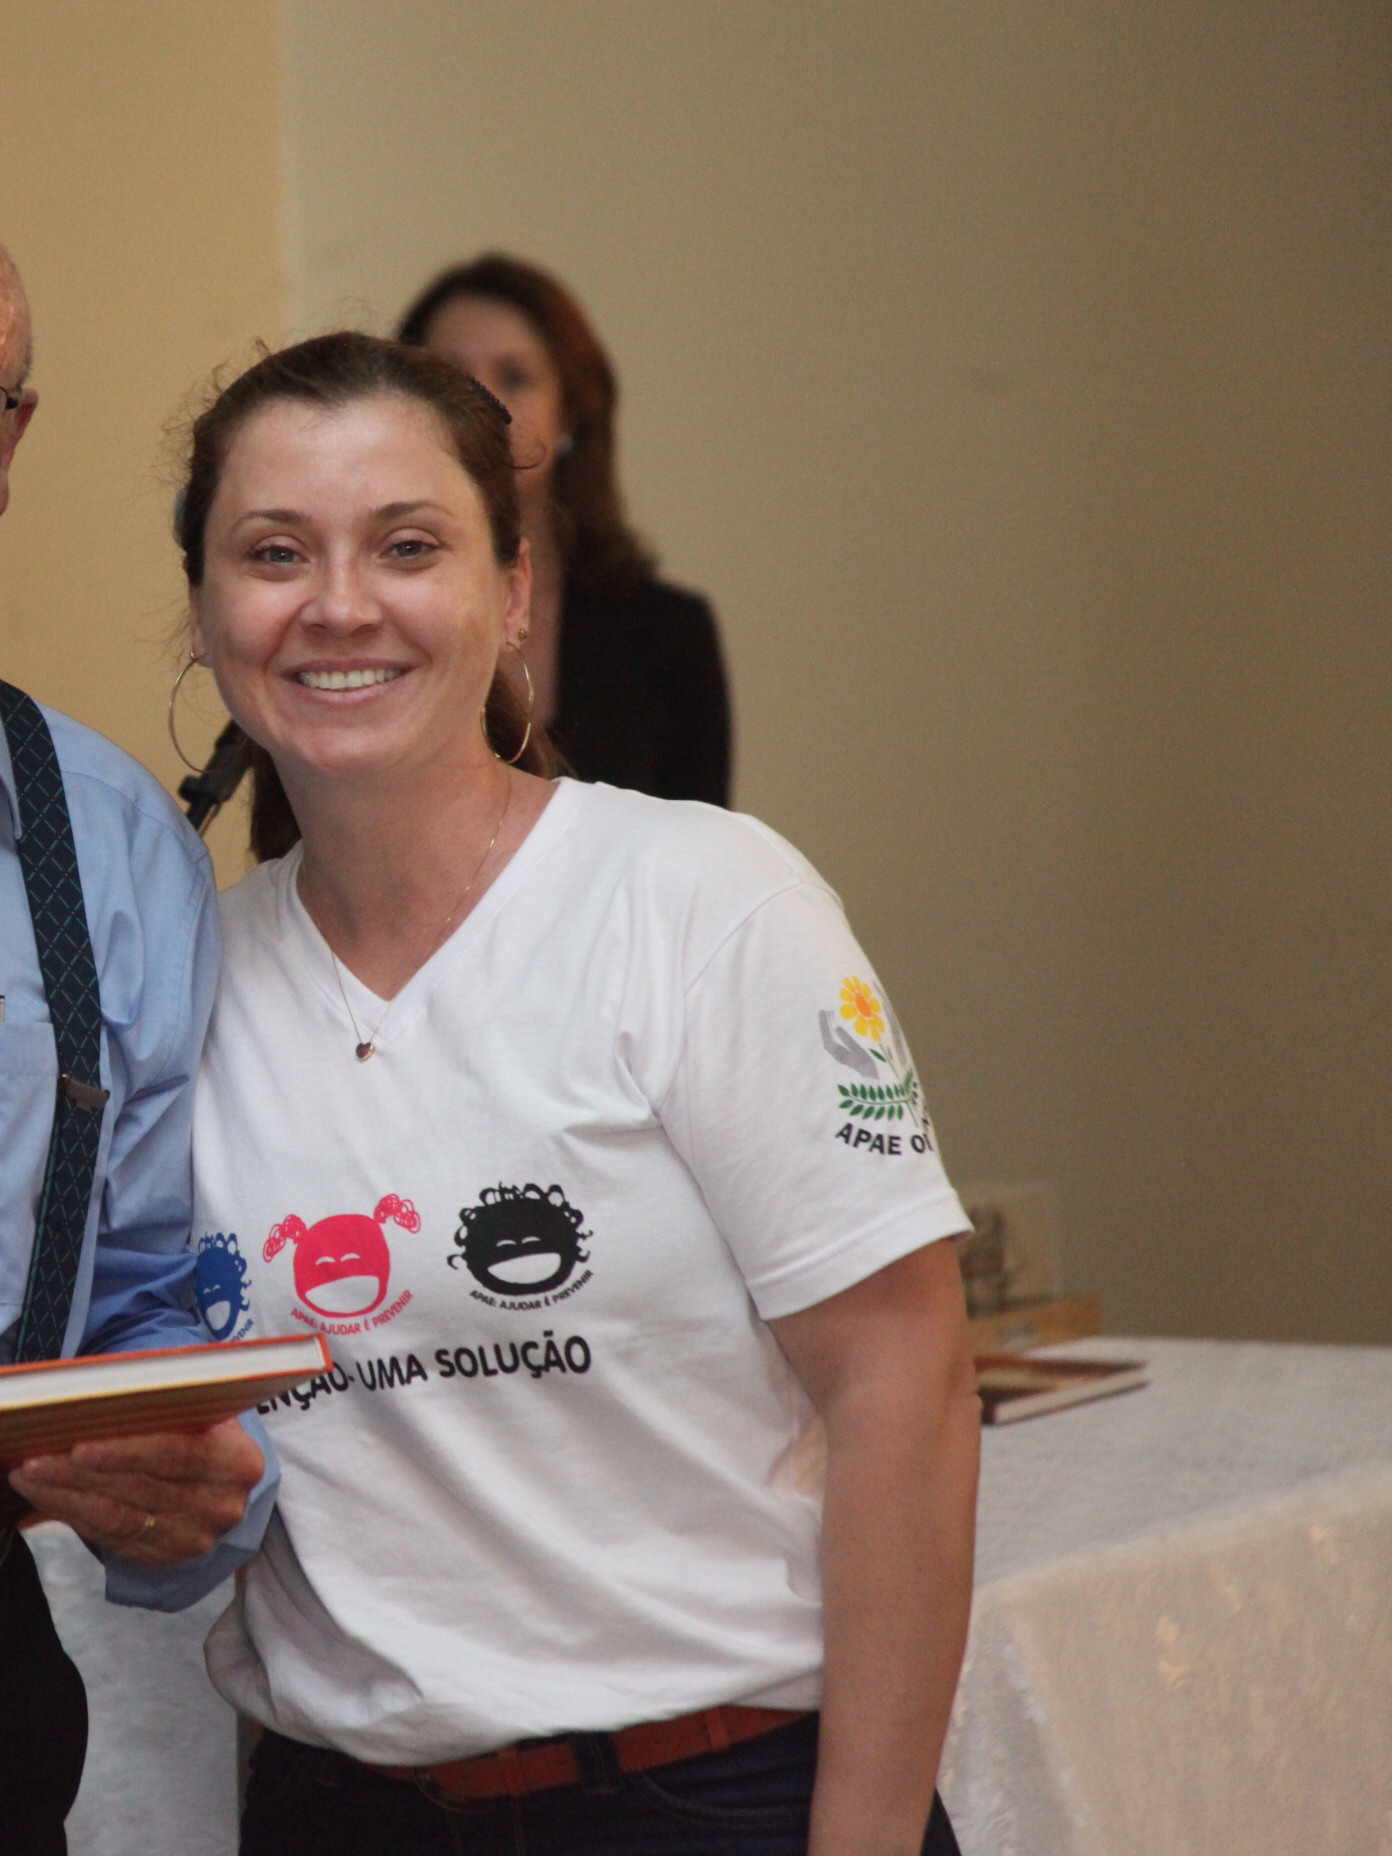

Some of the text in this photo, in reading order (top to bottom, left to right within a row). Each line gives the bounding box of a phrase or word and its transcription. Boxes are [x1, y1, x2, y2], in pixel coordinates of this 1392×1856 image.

[835, 1122, 902, 1155] APAE
[319, 1322, 362, 1335] AJUDAR
[363, 1316, 371, 1331] É
[372, 1288, 414, 1328] PREVENIR
[499, 1300, 542, 1311] AJUDAR
[552, 1269, 594, 1303] PREVENIR
[434, 1330, 593, 1378] SOLUÇÃO
